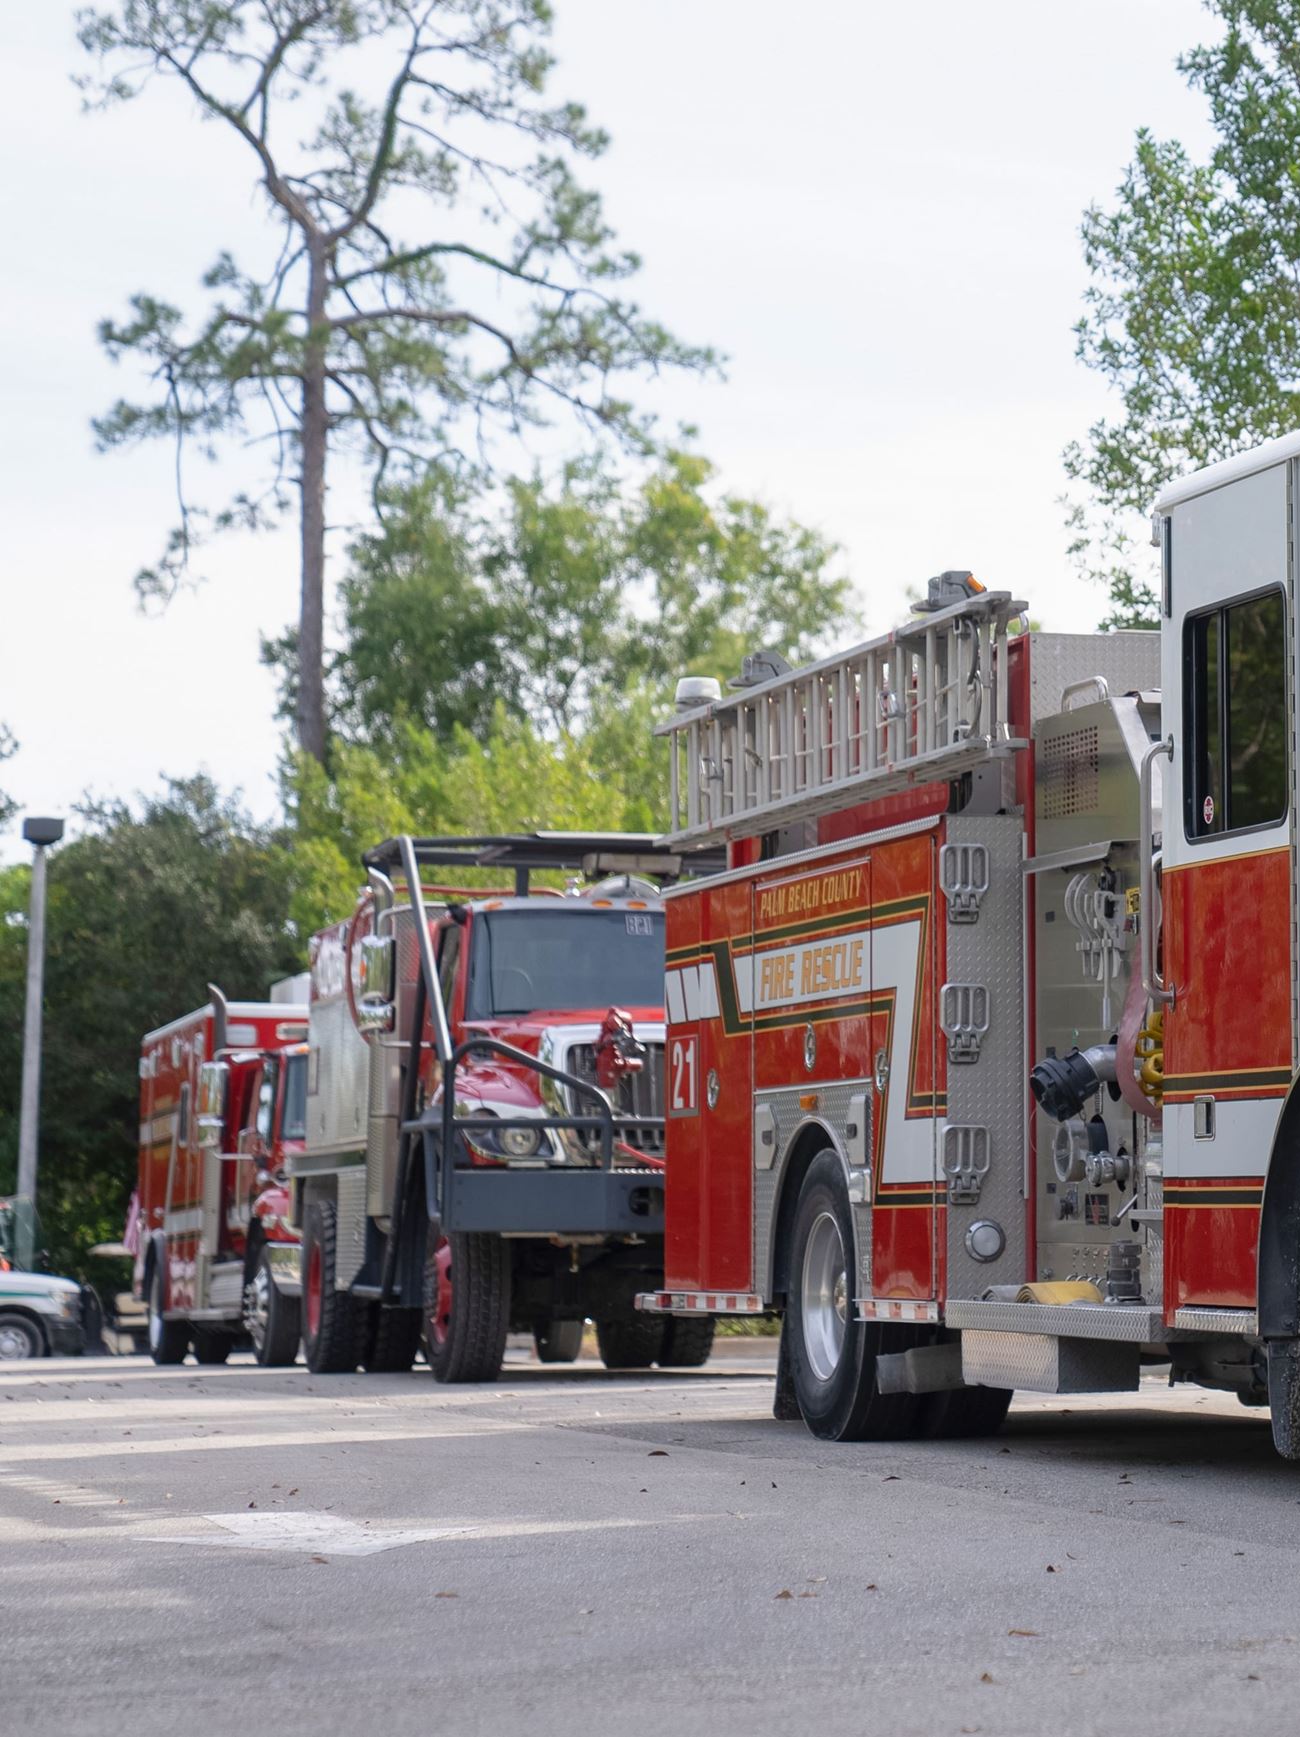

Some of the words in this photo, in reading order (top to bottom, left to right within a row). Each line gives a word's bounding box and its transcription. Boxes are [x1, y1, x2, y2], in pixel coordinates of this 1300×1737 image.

[760, 887, 786, 919] PALM
[788, 879, 820, 913] BEACH
[822, 870, 862, 905] COUNTY
[760, 953, 795, 1002] FIRE
[800, 940, 864, 996] RESCUE
[672, 1039, 695, 1109] 21
